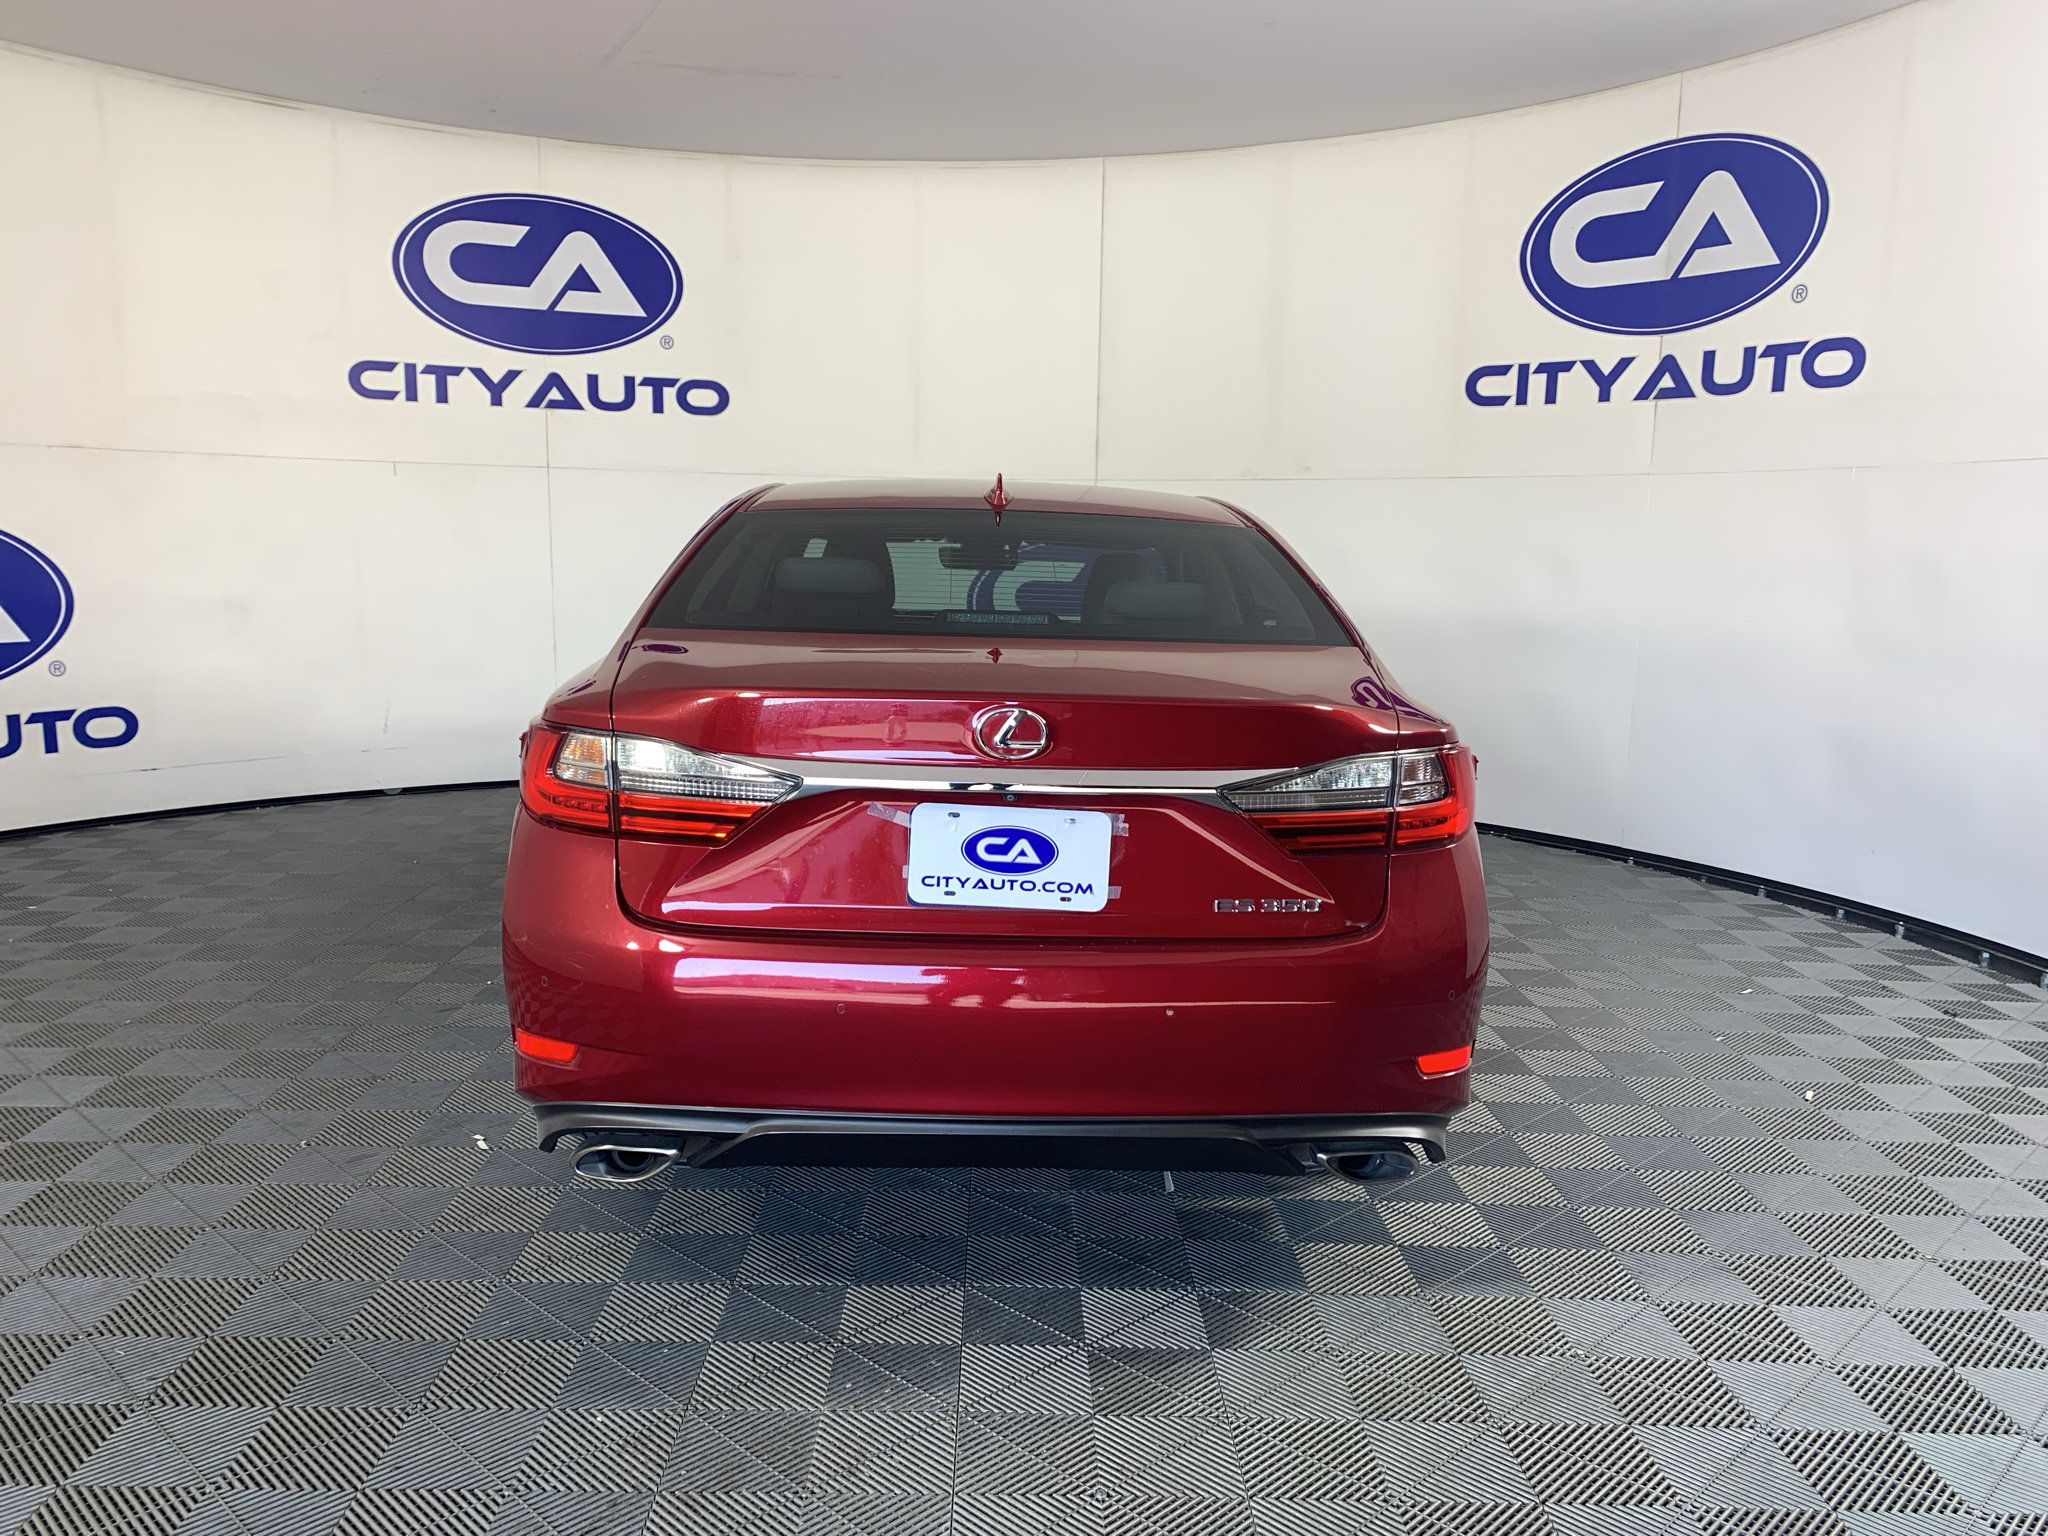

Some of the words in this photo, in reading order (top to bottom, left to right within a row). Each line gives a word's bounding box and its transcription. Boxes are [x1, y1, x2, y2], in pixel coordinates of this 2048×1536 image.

[1549, 169, 1782, 289] CA
[422, 219, 648, 318] CA
[976, 837, 1042, 865] CA
[921, 875, 1094, 895] CITYAUTO.COM
[1213, 899, 1255, 913] ES
[1261, 899, 1322, 913] 350
